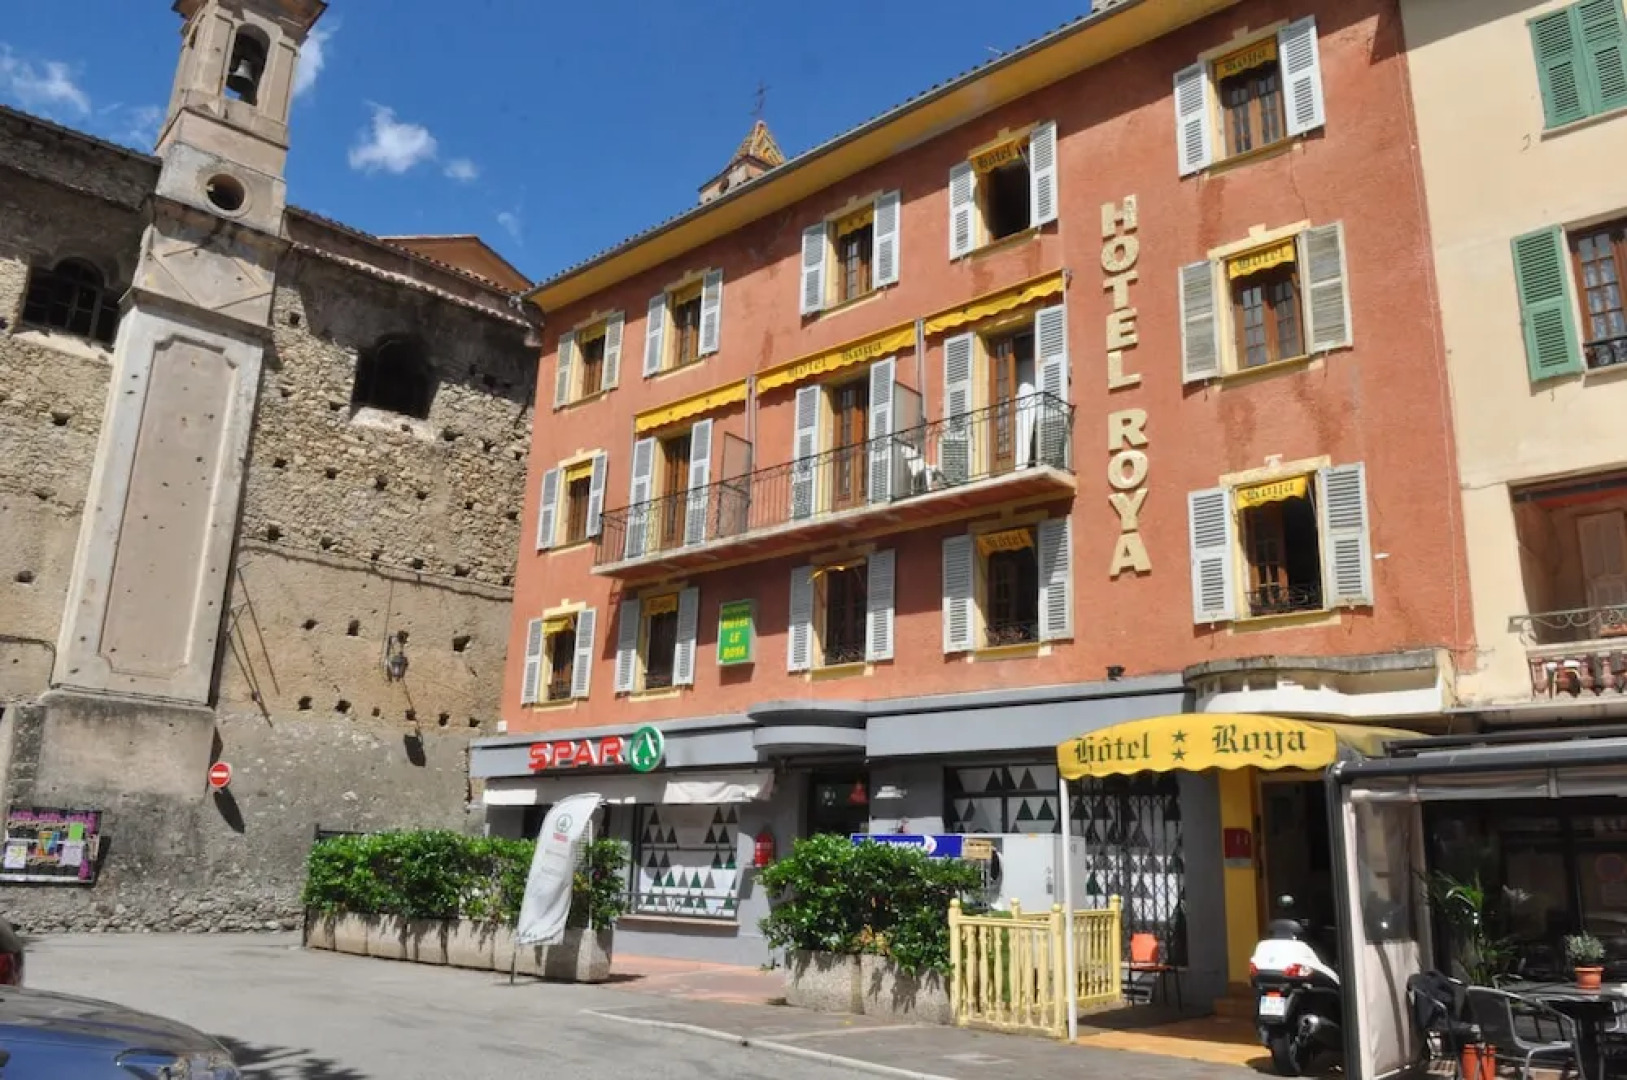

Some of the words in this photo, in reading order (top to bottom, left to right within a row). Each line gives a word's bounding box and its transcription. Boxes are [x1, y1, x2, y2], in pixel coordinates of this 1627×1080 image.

[1100, 194, 1142, 393] HOTEL
[1108, 408, 1152, 581] ROYA
[528, 735, 624, 771] SPAR
[1074, 732, 1150, 764] Hôtel
[1212, 724, 1307, 760] Roya
